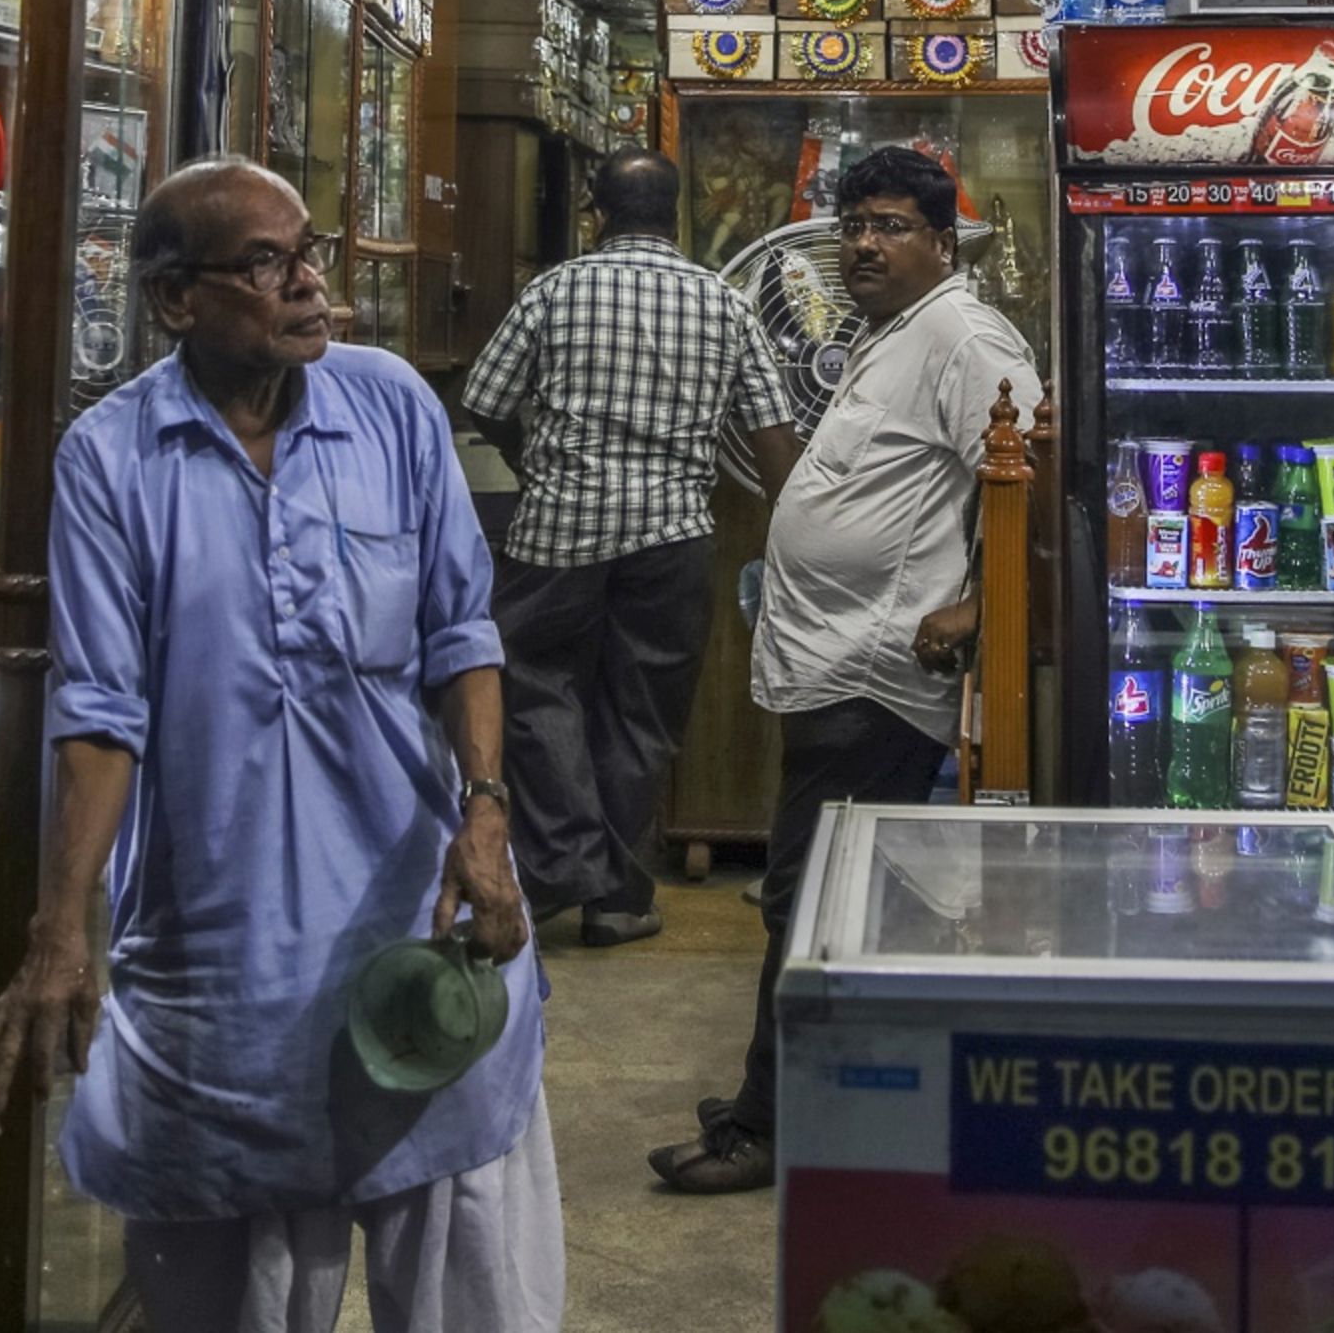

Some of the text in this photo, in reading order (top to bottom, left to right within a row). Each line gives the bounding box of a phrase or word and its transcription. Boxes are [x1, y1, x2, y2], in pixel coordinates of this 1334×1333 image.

[1126, 184, 1149, 203] 15
[1167, 184, 1191, 204] 20
[1208, 184, 1231, 204] 30
[1251, 183, 1276, 203] 40
[1192, 687, 1231, 715] Sprite
[969, 1057, 1039, 1107] WE
[1053, 1060, 1173, 1112] TAKE
[1043, 1124, 1242, 1188] 96818
